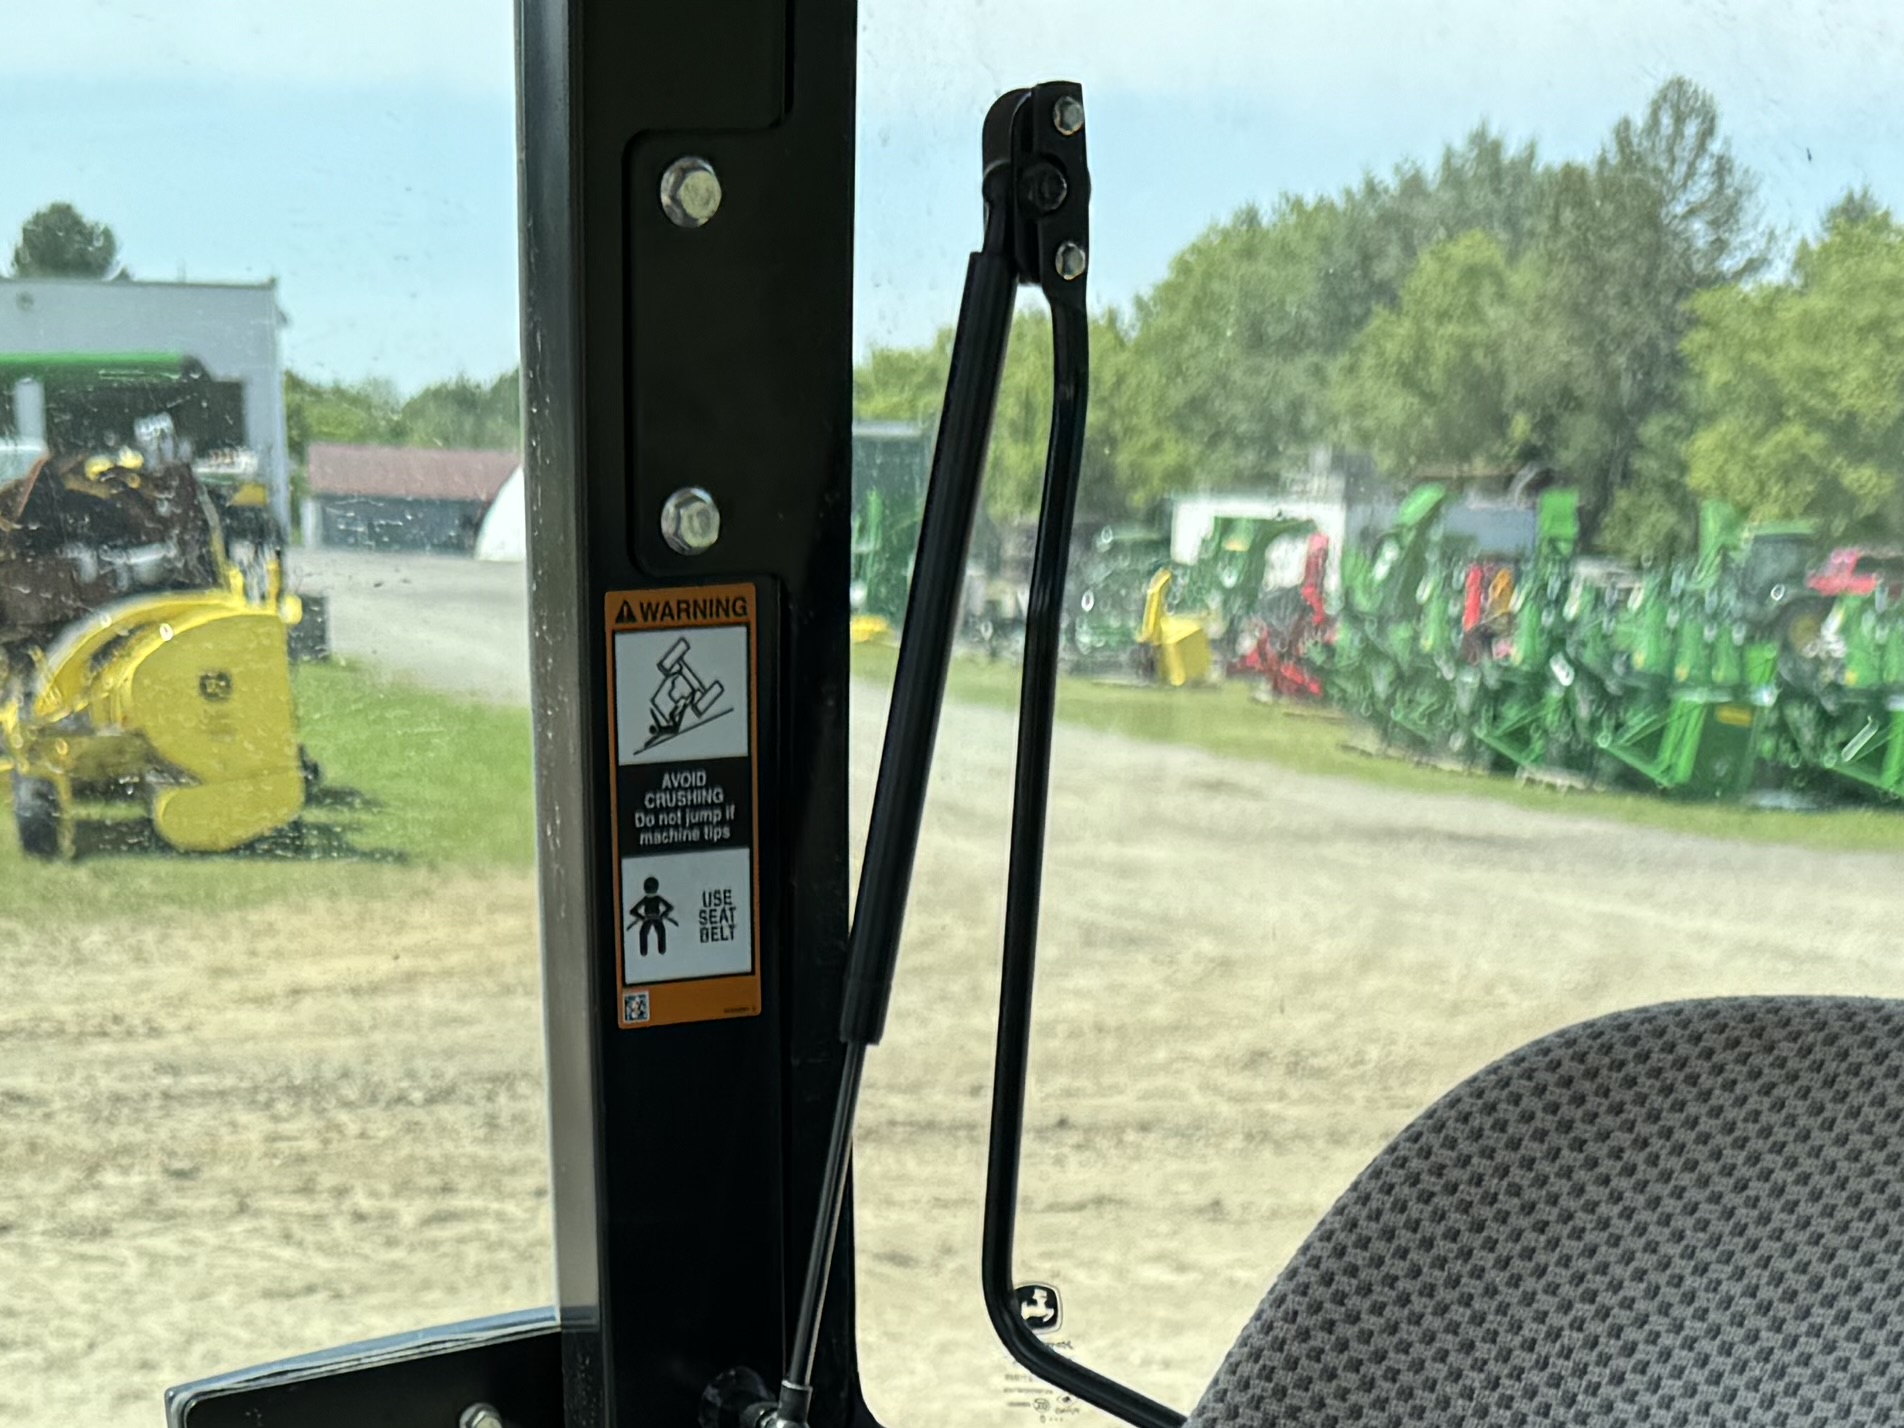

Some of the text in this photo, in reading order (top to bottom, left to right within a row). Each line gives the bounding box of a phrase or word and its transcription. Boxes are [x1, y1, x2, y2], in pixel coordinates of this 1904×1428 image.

[639, 596, 748, 622] WARNING
[661, 769, 707, 789] AVOID
[644, 786, 724, 809] CRUSHING
[635, 803, 736, 828] Do not jump if
[639, 824, 731, 846] machine tips
[702, 889, 733, 907] USE
[699, 906, 737, 925] SEAT
[699, 924, 737, 943] BELT
